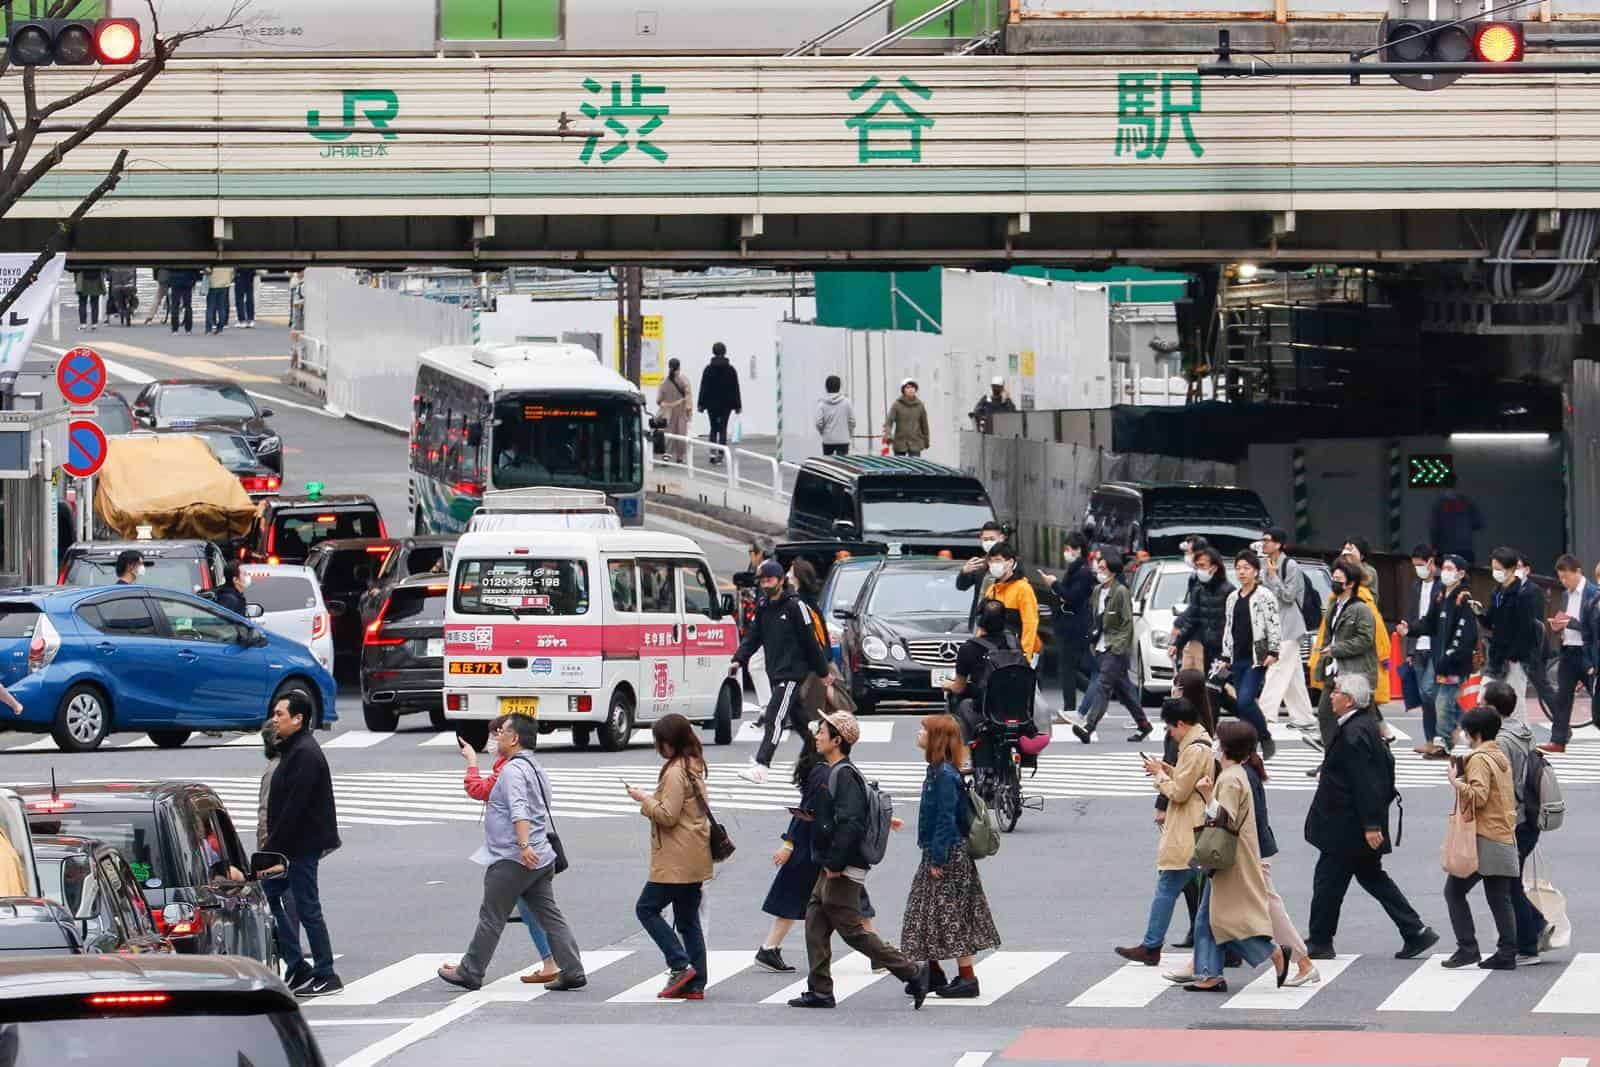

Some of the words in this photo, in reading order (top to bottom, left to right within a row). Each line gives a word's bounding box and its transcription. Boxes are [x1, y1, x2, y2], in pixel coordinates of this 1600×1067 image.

[307, 88, 399, 141] JR
[579, 72, 1205, 164] 渋谷駅
[320, 143, 389, 158] JR東日本
[450, 662, 500, 673] 高圧ガス
